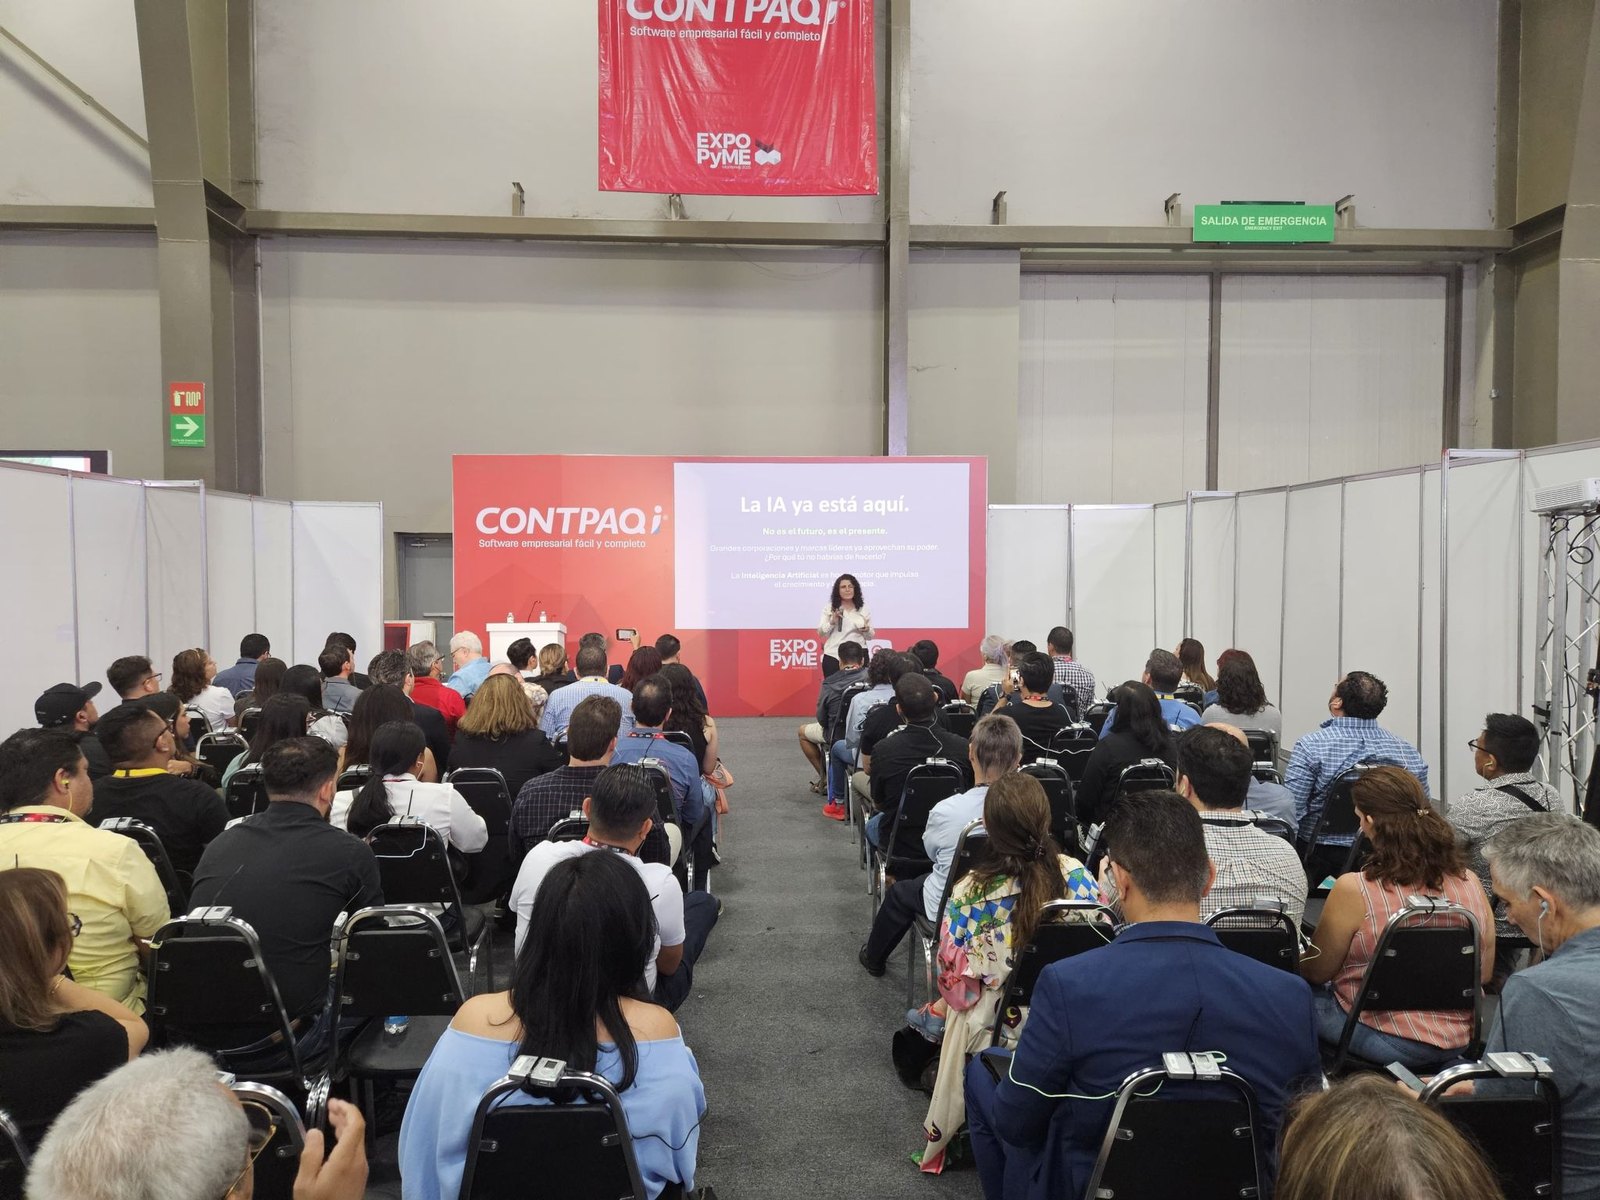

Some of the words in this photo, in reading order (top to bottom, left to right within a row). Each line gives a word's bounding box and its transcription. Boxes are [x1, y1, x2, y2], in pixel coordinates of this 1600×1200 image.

[629, 26, 676, 39] Software
[679, 28, 738, 40] empresarial
[740, 27, 763, 40] fácil
[764, 31, 771, 42] y
[773, 29, 821, 42] completo
[696, 132, 751, 150] EXPO
[696, 149, 751, 169] PyME
[1200, 216, 1239, 226] SALIDA
[1241, 216, 1256, 226] DE
[1257, 216, 1327, 226] EMERGENCIA
[740, 496, 761, 513] La
[767, 496, 787, 513] IA
[792, 499, 813, 516] ya
[819, 495, 858, 513] está
[863, 495, 910, 516] aquí.
[762, 527, 775, 535] No
[788, 527, 796, 535] el
[797, 527, 826, 536] futuro,
[838, 527, 847, 535] el
[848, 527, 888, 537] presente.
[478, 538, 519, 549] Software
[521, 538, 573, 549] empresarial
[575, 538, 595, 549] fácil
[596, 541, 603, 550] y
[604, 539, 646, 550] completo
[710, 544, 742, 552] Grandes
[742, 544, 794, 553] corporaciones
[794, 545, 800, 553] y
[853, 545, 862, 553] ya
[863, 544, 906, 553] aprovechan
[764, 553, 780, 562] ¿Por
[854, 552, 887, 561] hacerlo?
[741, 571, 786, 580] Inteligencia
[786, 571, 820, 579] Artificial
[769, 639, 818, 653] EXPO
[769, 652, 818, 669] PyME
